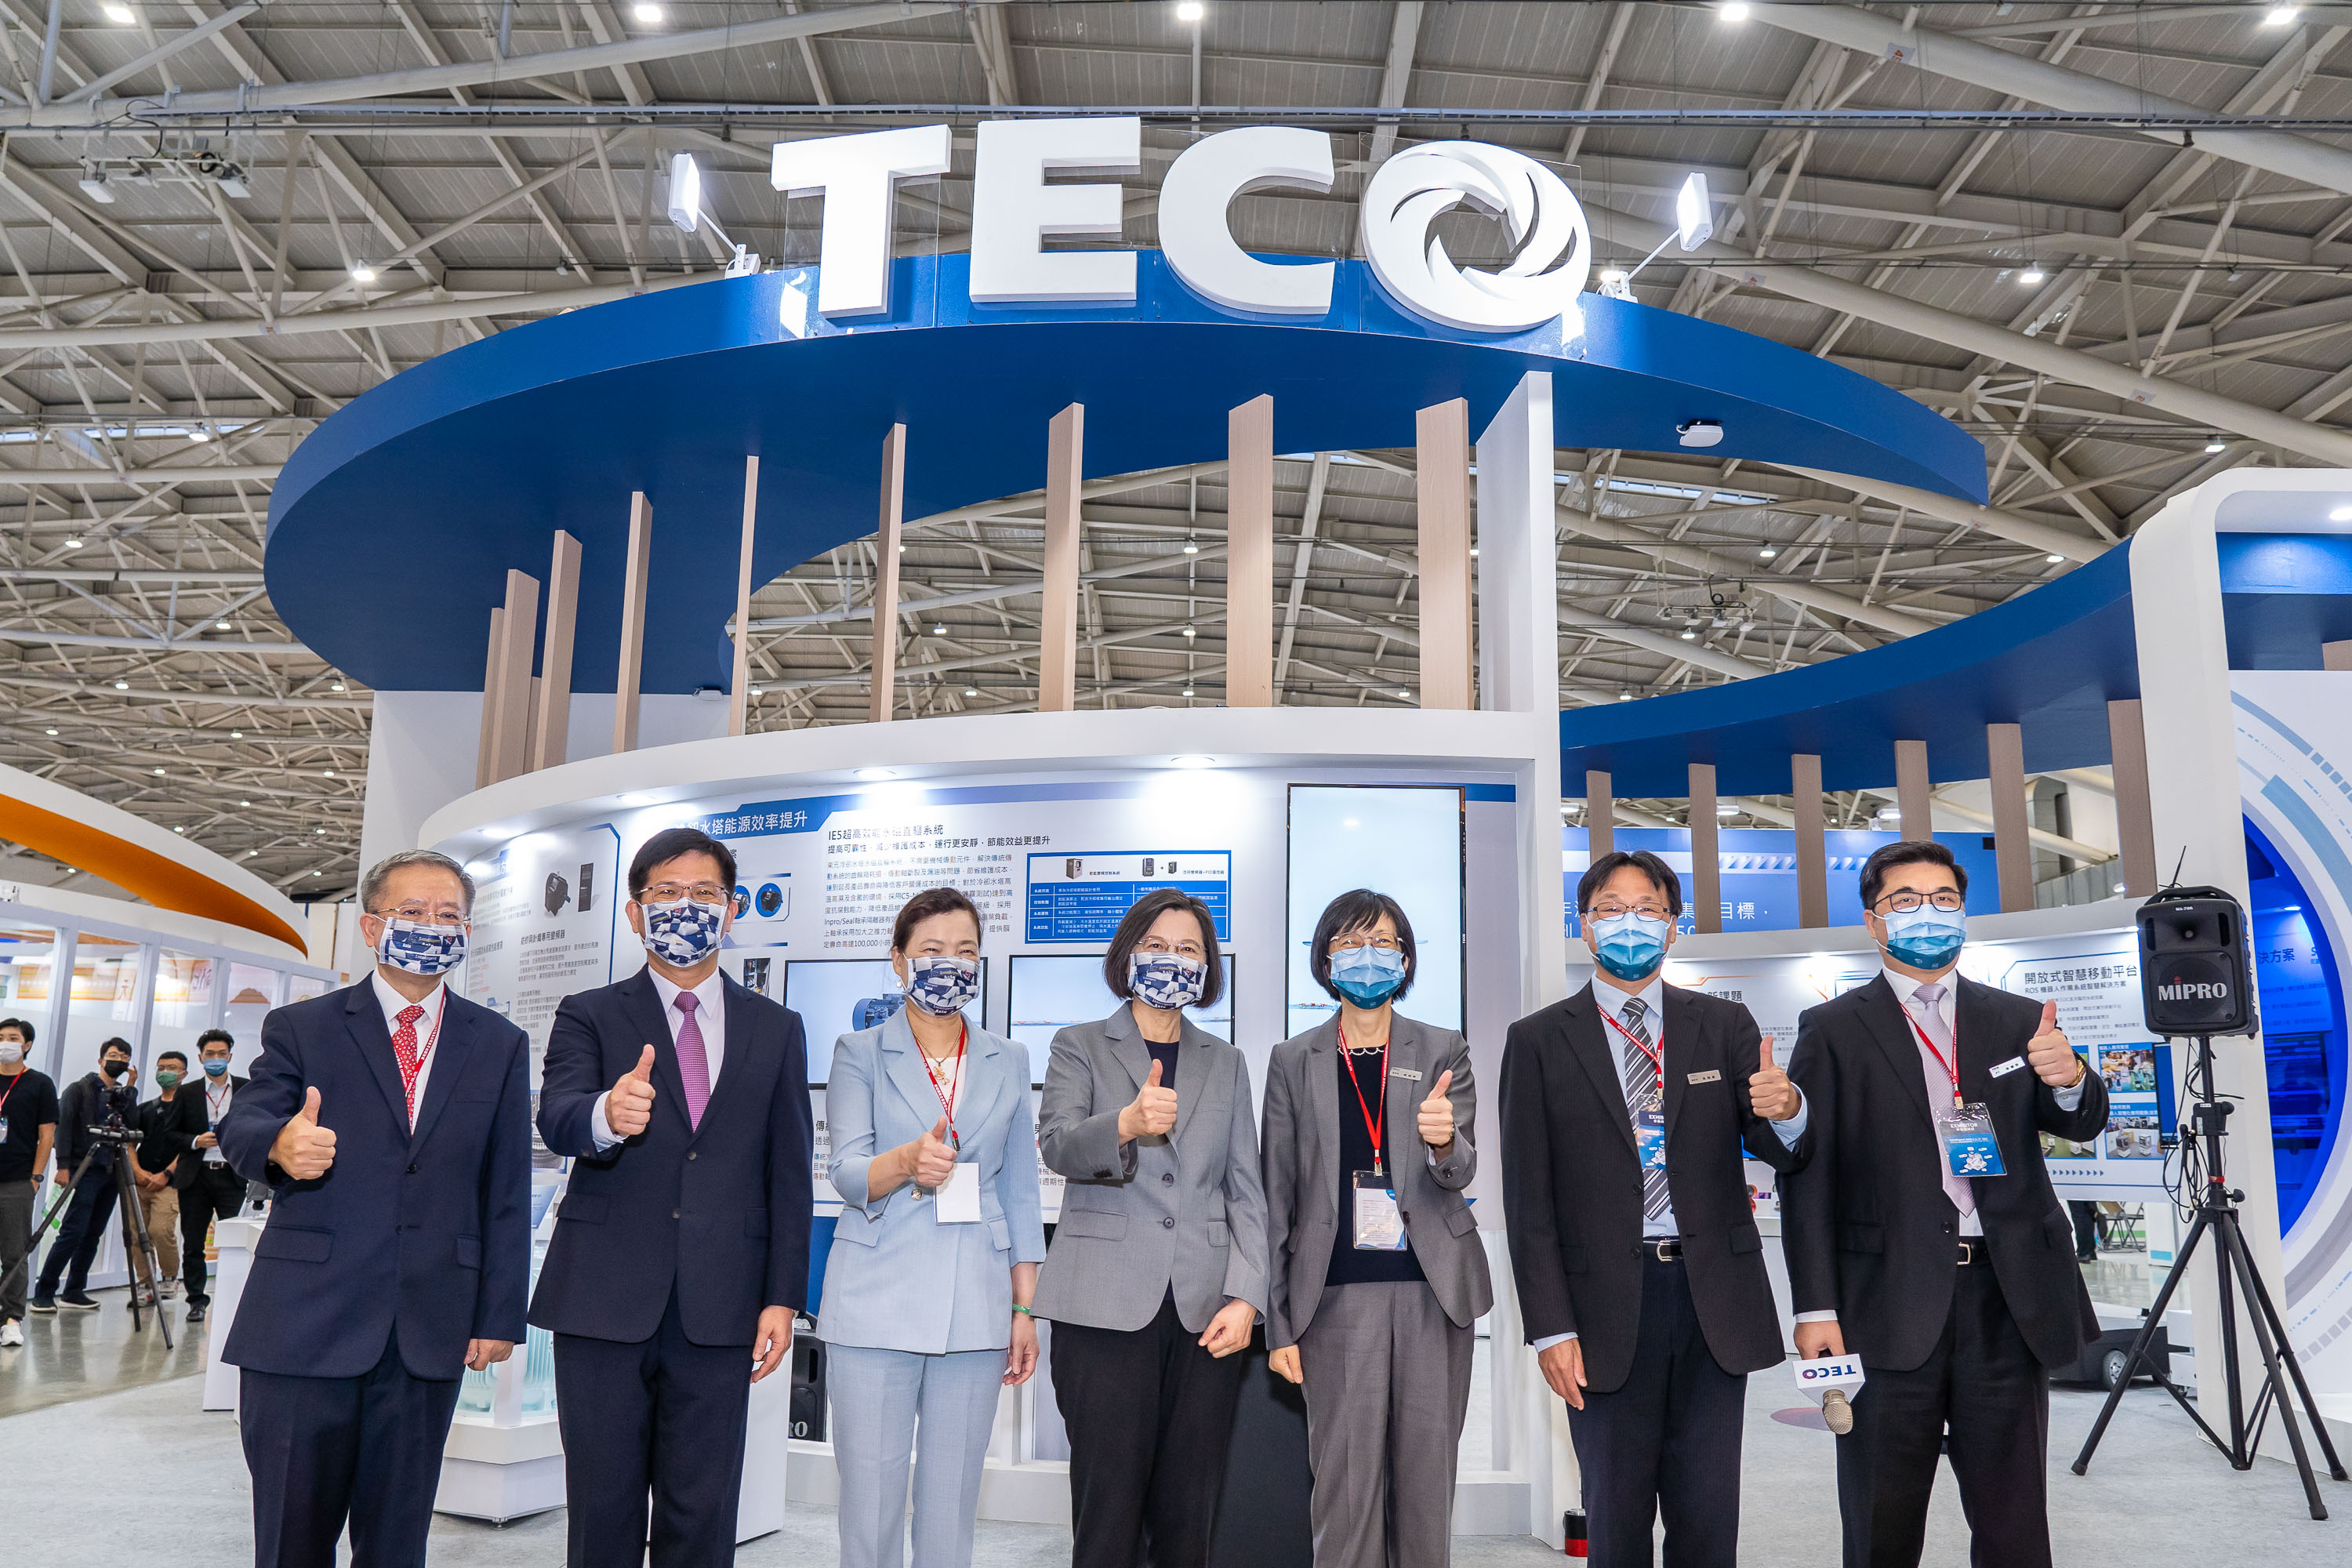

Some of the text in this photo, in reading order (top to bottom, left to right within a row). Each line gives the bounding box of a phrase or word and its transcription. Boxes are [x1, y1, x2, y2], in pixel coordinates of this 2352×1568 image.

[771, 116, 1593, 334] TECO
[2024, 964, 2138, 985] 開放式智慧移動平台
[1802, 1364, 1857, 1380] TECO
